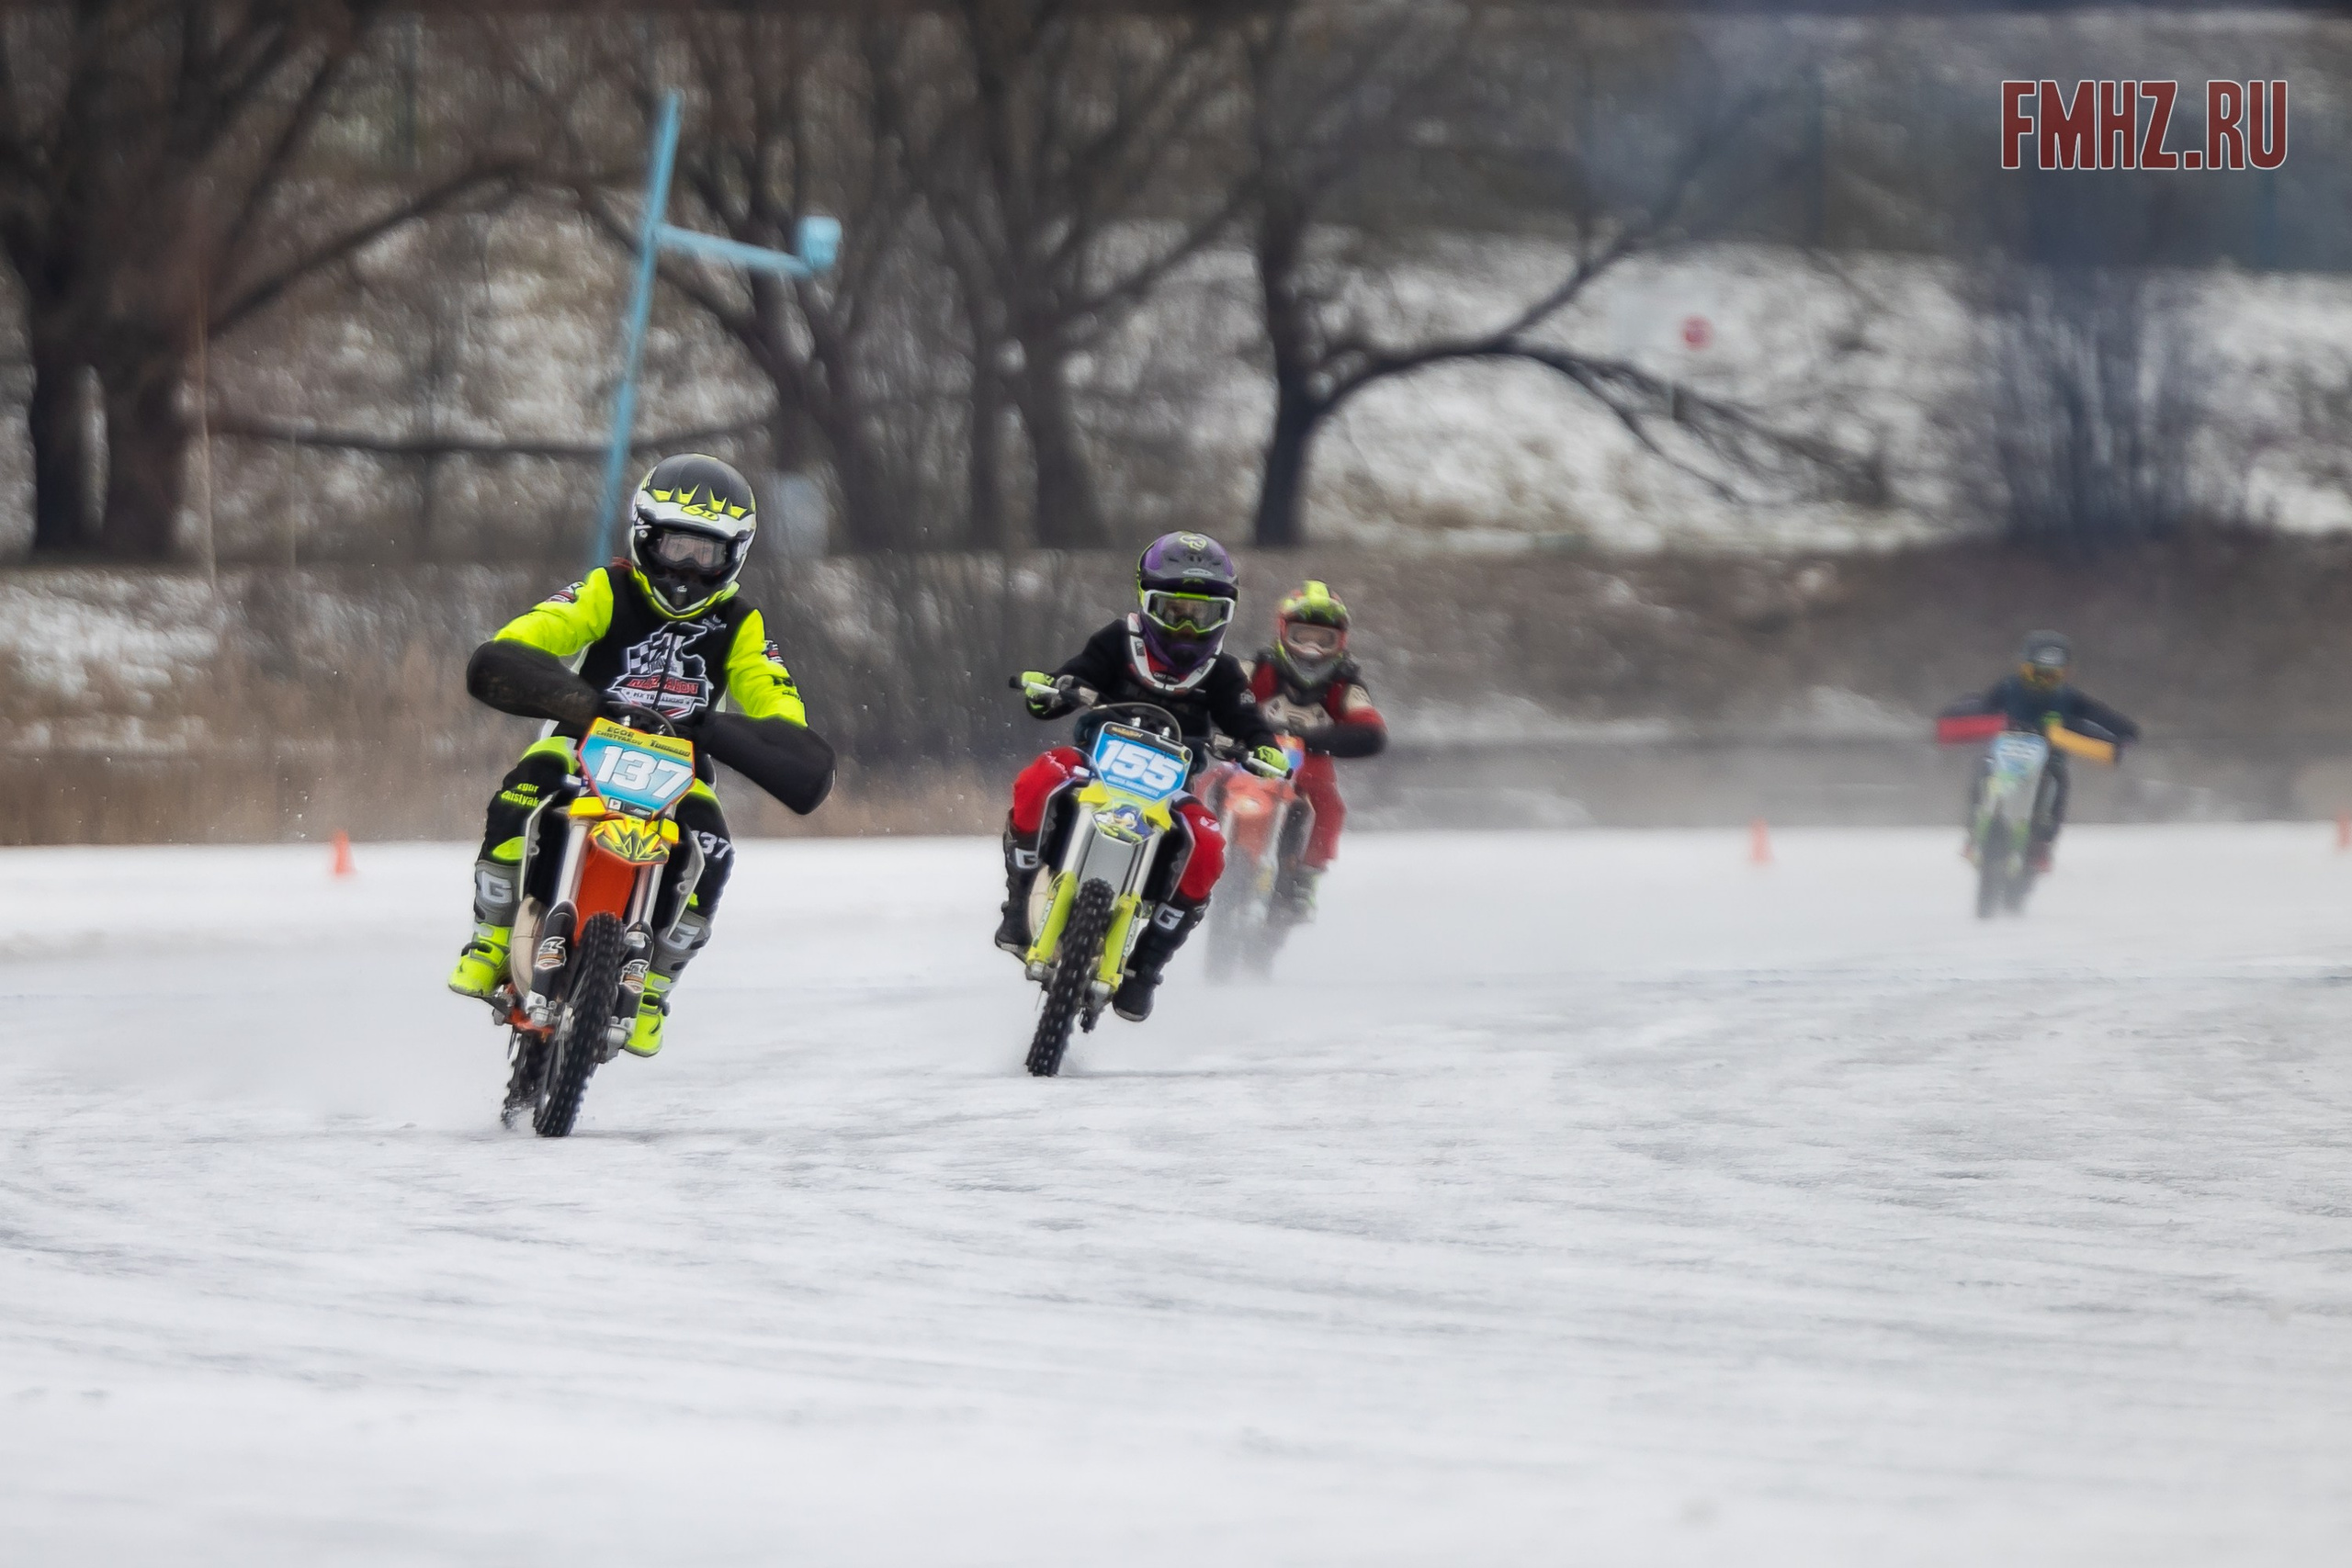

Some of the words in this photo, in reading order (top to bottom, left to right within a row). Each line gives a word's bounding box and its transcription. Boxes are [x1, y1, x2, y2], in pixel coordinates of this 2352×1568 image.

[606, 726, 635, 739] EGOR
[595, 745, 694, 799] 137
[1098, 739, 1184, 790] 155
